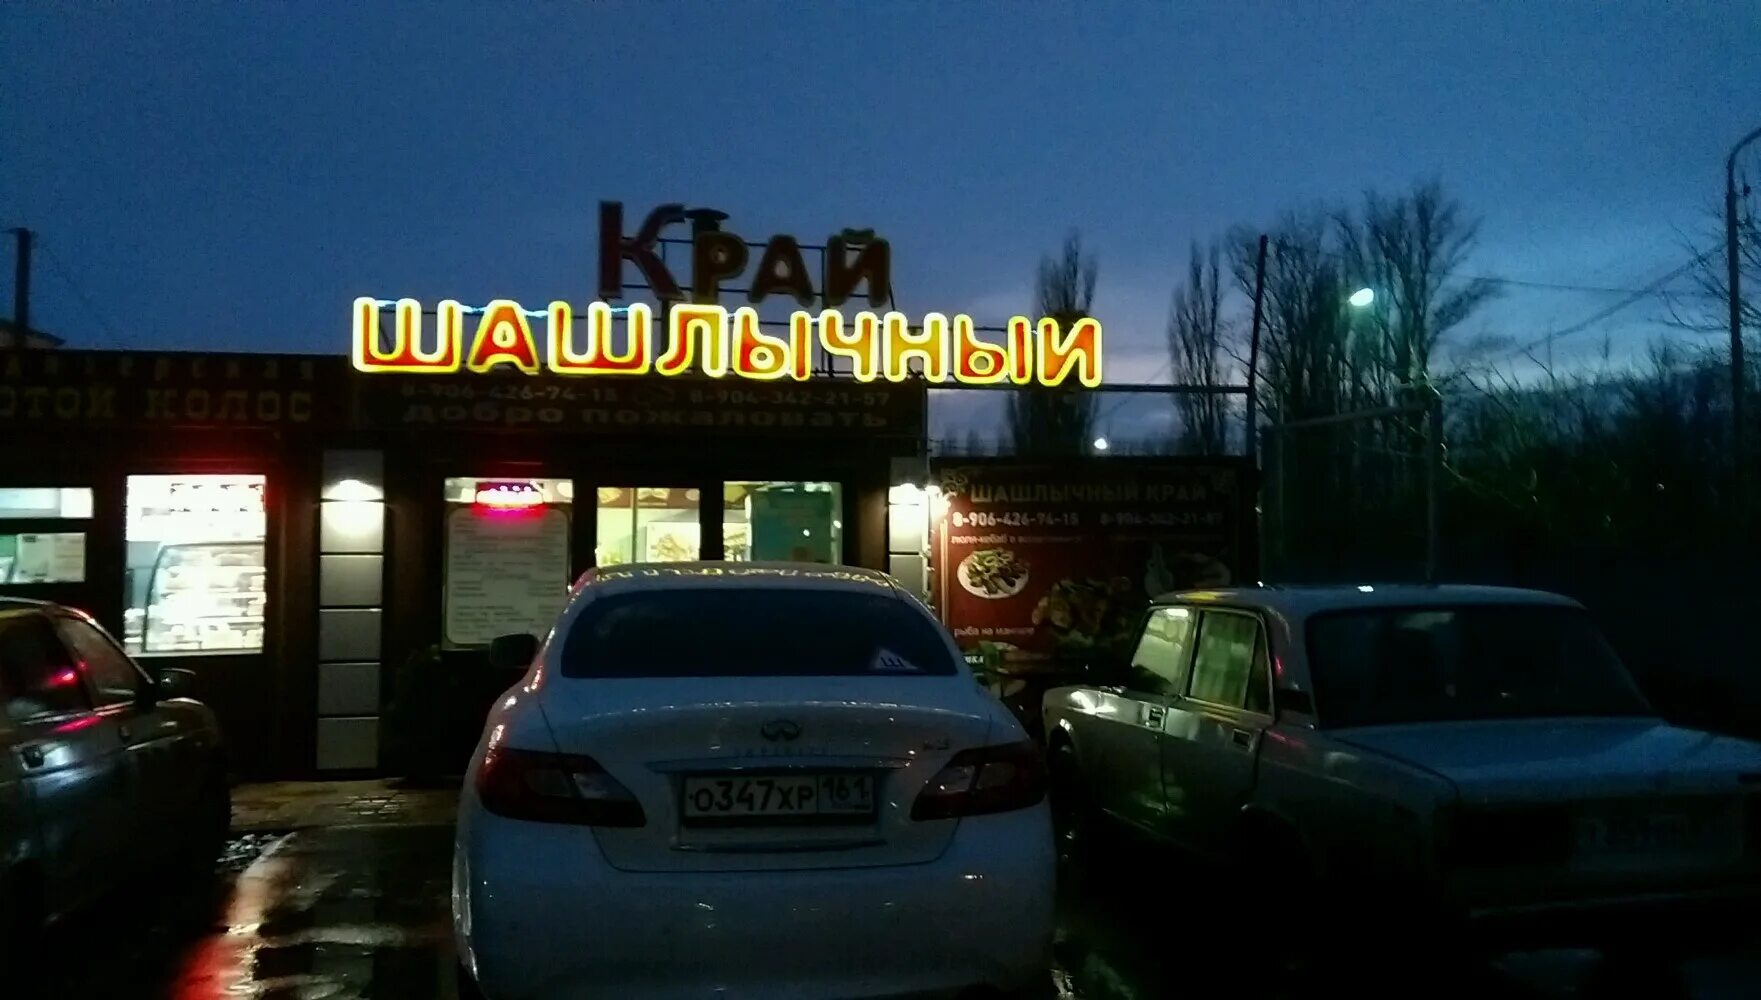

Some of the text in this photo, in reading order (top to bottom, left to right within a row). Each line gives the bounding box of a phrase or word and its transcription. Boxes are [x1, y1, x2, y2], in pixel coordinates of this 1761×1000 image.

[144, 386, 313, 422] КОЛОС
[576, 407, 887, 427] пожаловать
[970, 483, 1207, 503] ШАШЛЫЧНЫЙ КРАЙ
[821, 777, 864, 801] 161
